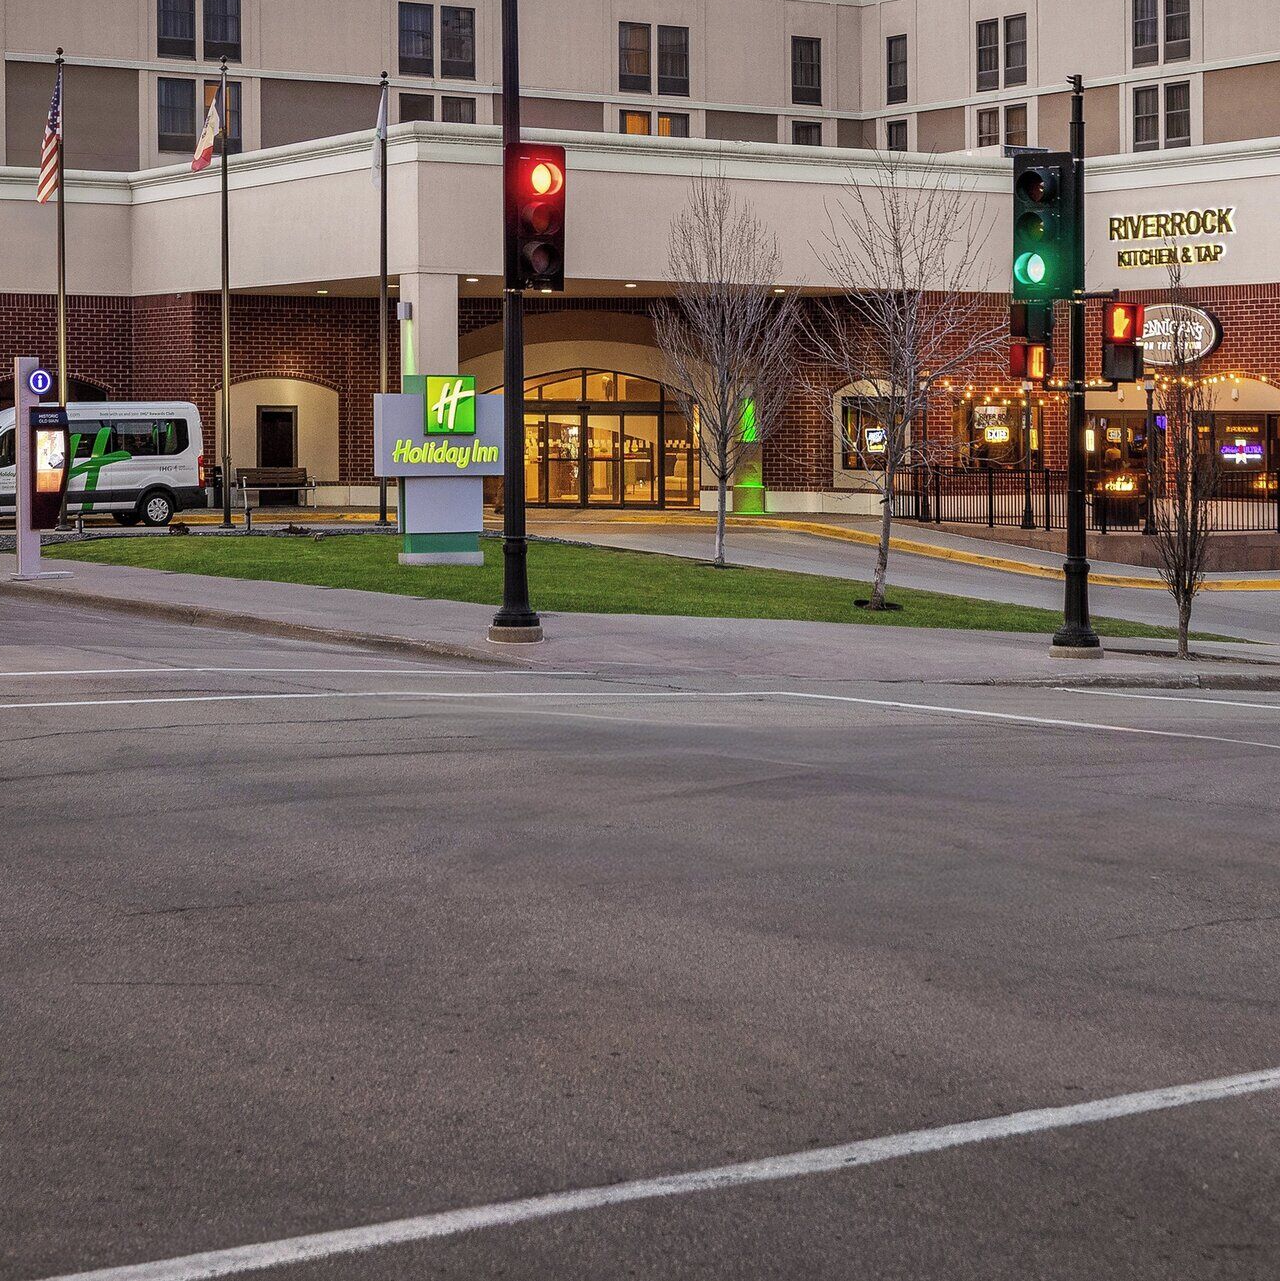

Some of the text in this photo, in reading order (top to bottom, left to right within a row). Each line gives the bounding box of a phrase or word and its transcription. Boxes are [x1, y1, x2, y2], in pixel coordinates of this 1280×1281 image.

[1109, 207, 1234, 241] RIVERROCK
[1117, 244, 1224, 267] KITCHEN & TAP
[392, 438, 499, 469] Holiday Inn
